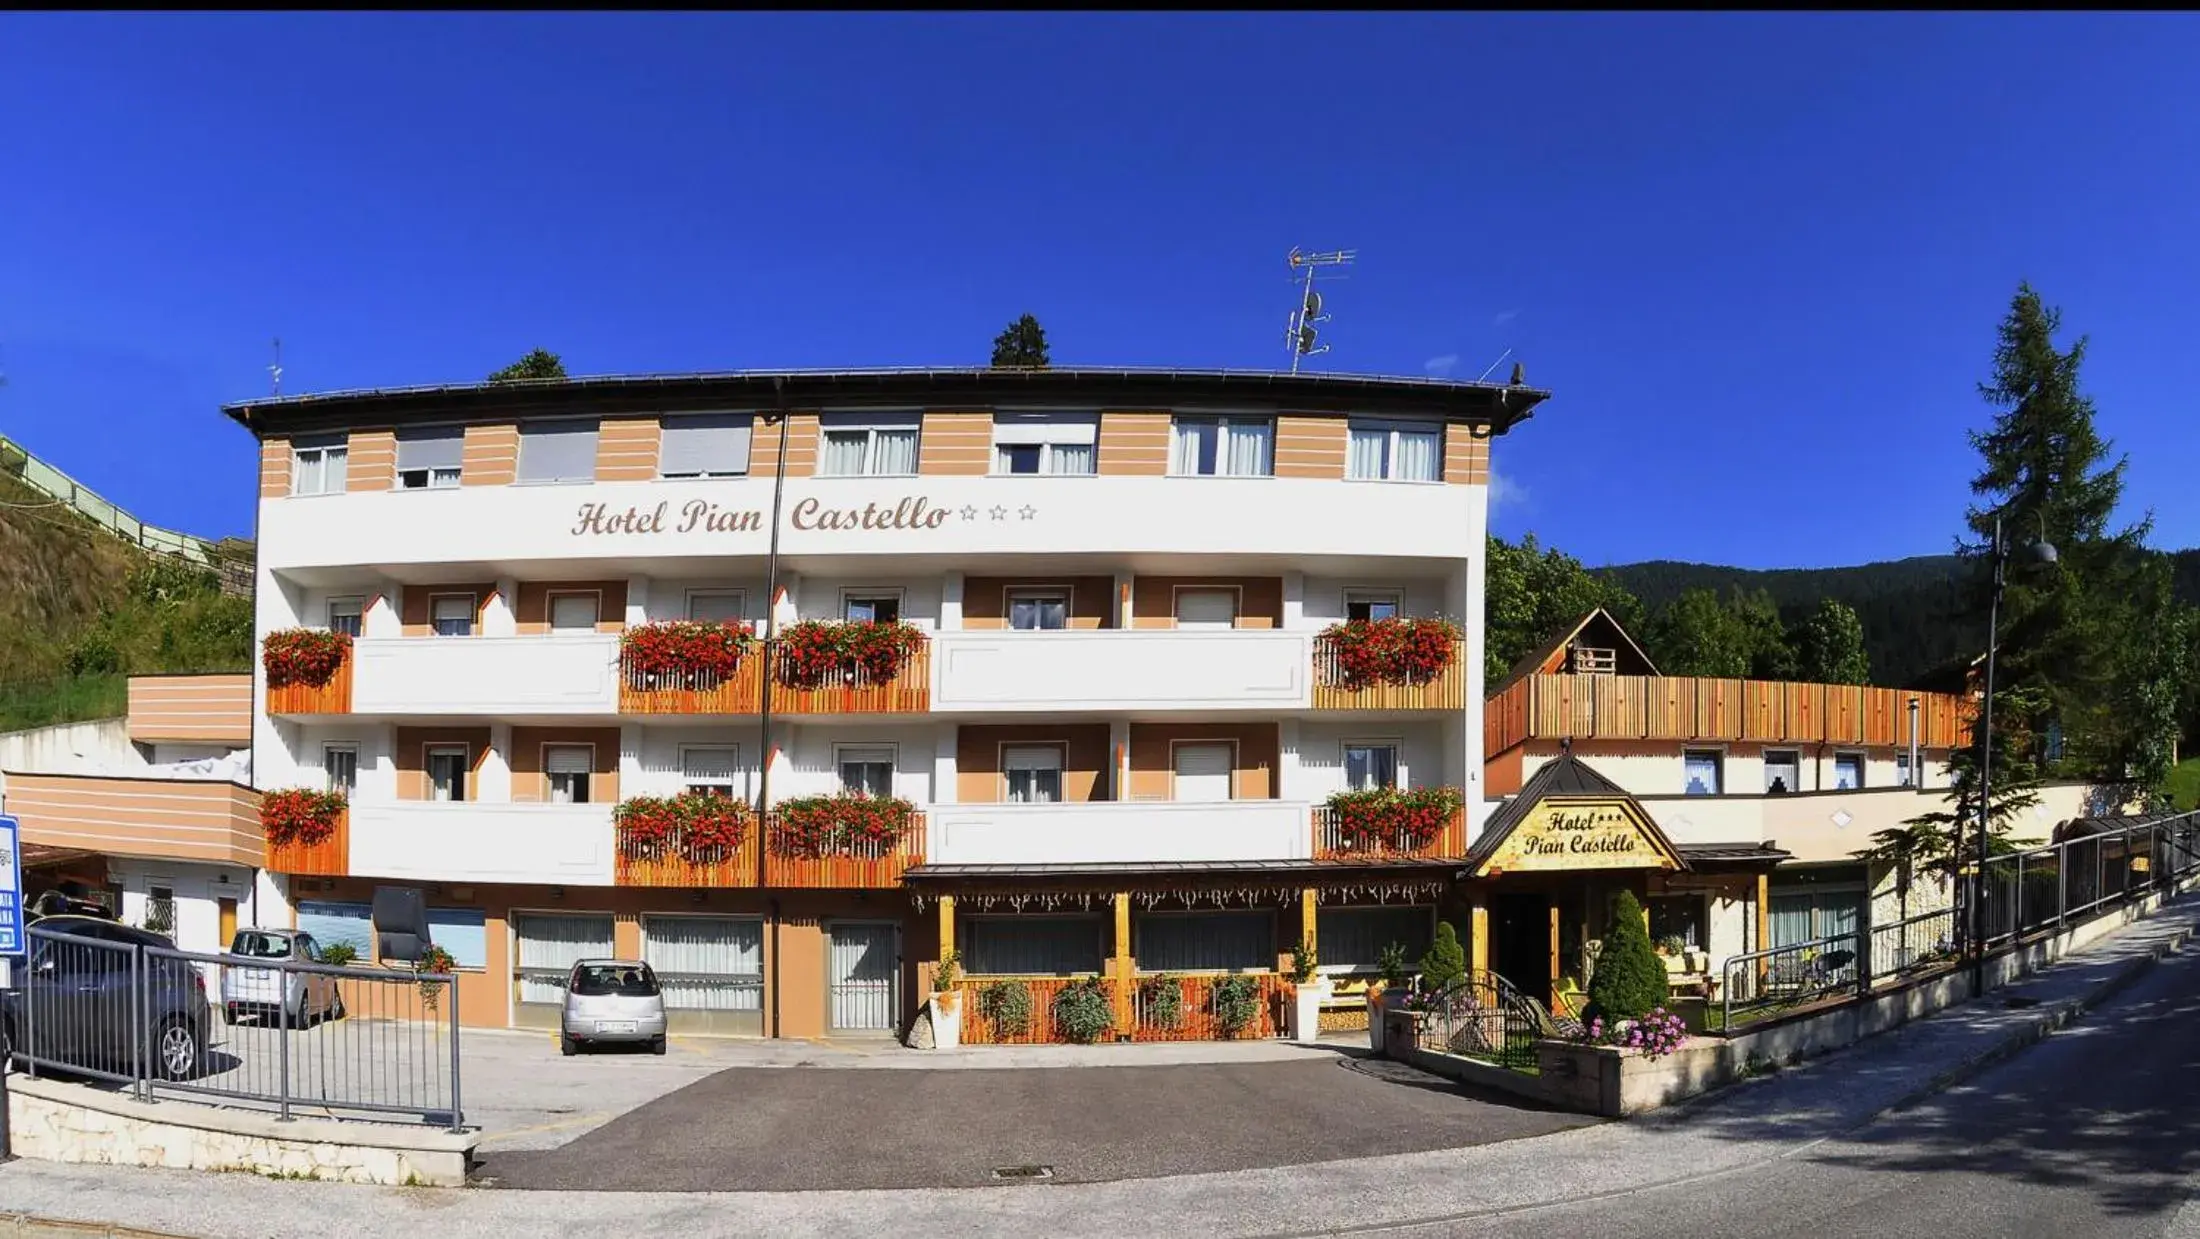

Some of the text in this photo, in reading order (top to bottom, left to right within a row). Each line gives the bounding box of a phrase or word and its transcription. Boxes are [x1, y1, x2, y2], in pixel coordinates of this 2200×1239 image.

[571, 496, 951, 536] Hotel Pian Castello
[1547, 812, 1595, 831] Hotel
[1524, 835, 1636, 855] Pian Castello
